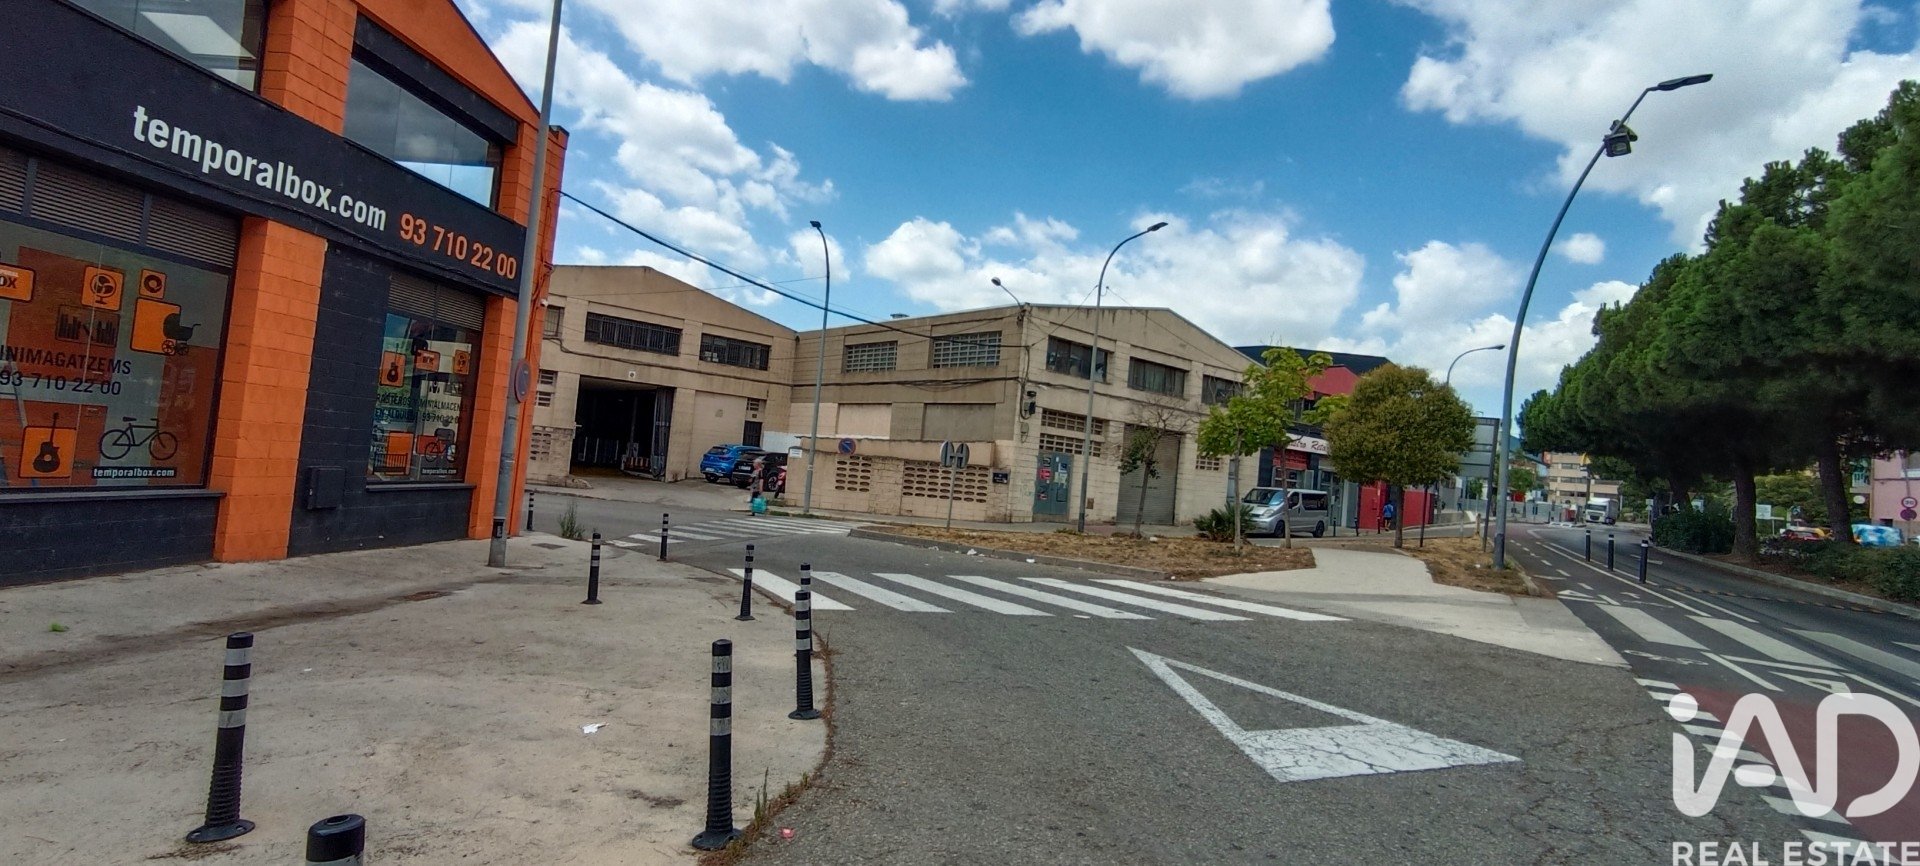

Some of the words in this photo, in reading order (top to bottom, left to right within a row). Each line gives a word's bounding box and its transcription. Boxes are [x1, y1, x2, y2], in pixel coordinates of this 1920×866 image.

[133, 105, 387, 231] temporalbox.com
[400, 213, 427, 245] 93
[433, 225, 468, 260] 710
[470, 242, 494, 271] 22
[496, 253, 517, 280] 00
[0, 369, 23, 387] 93
[31, 372, 67, 391] 710
[71, 377, 94, 394] 22
[100, 380, 122, 396] 00
[93, 468, 175, 478] temporalbox.com
